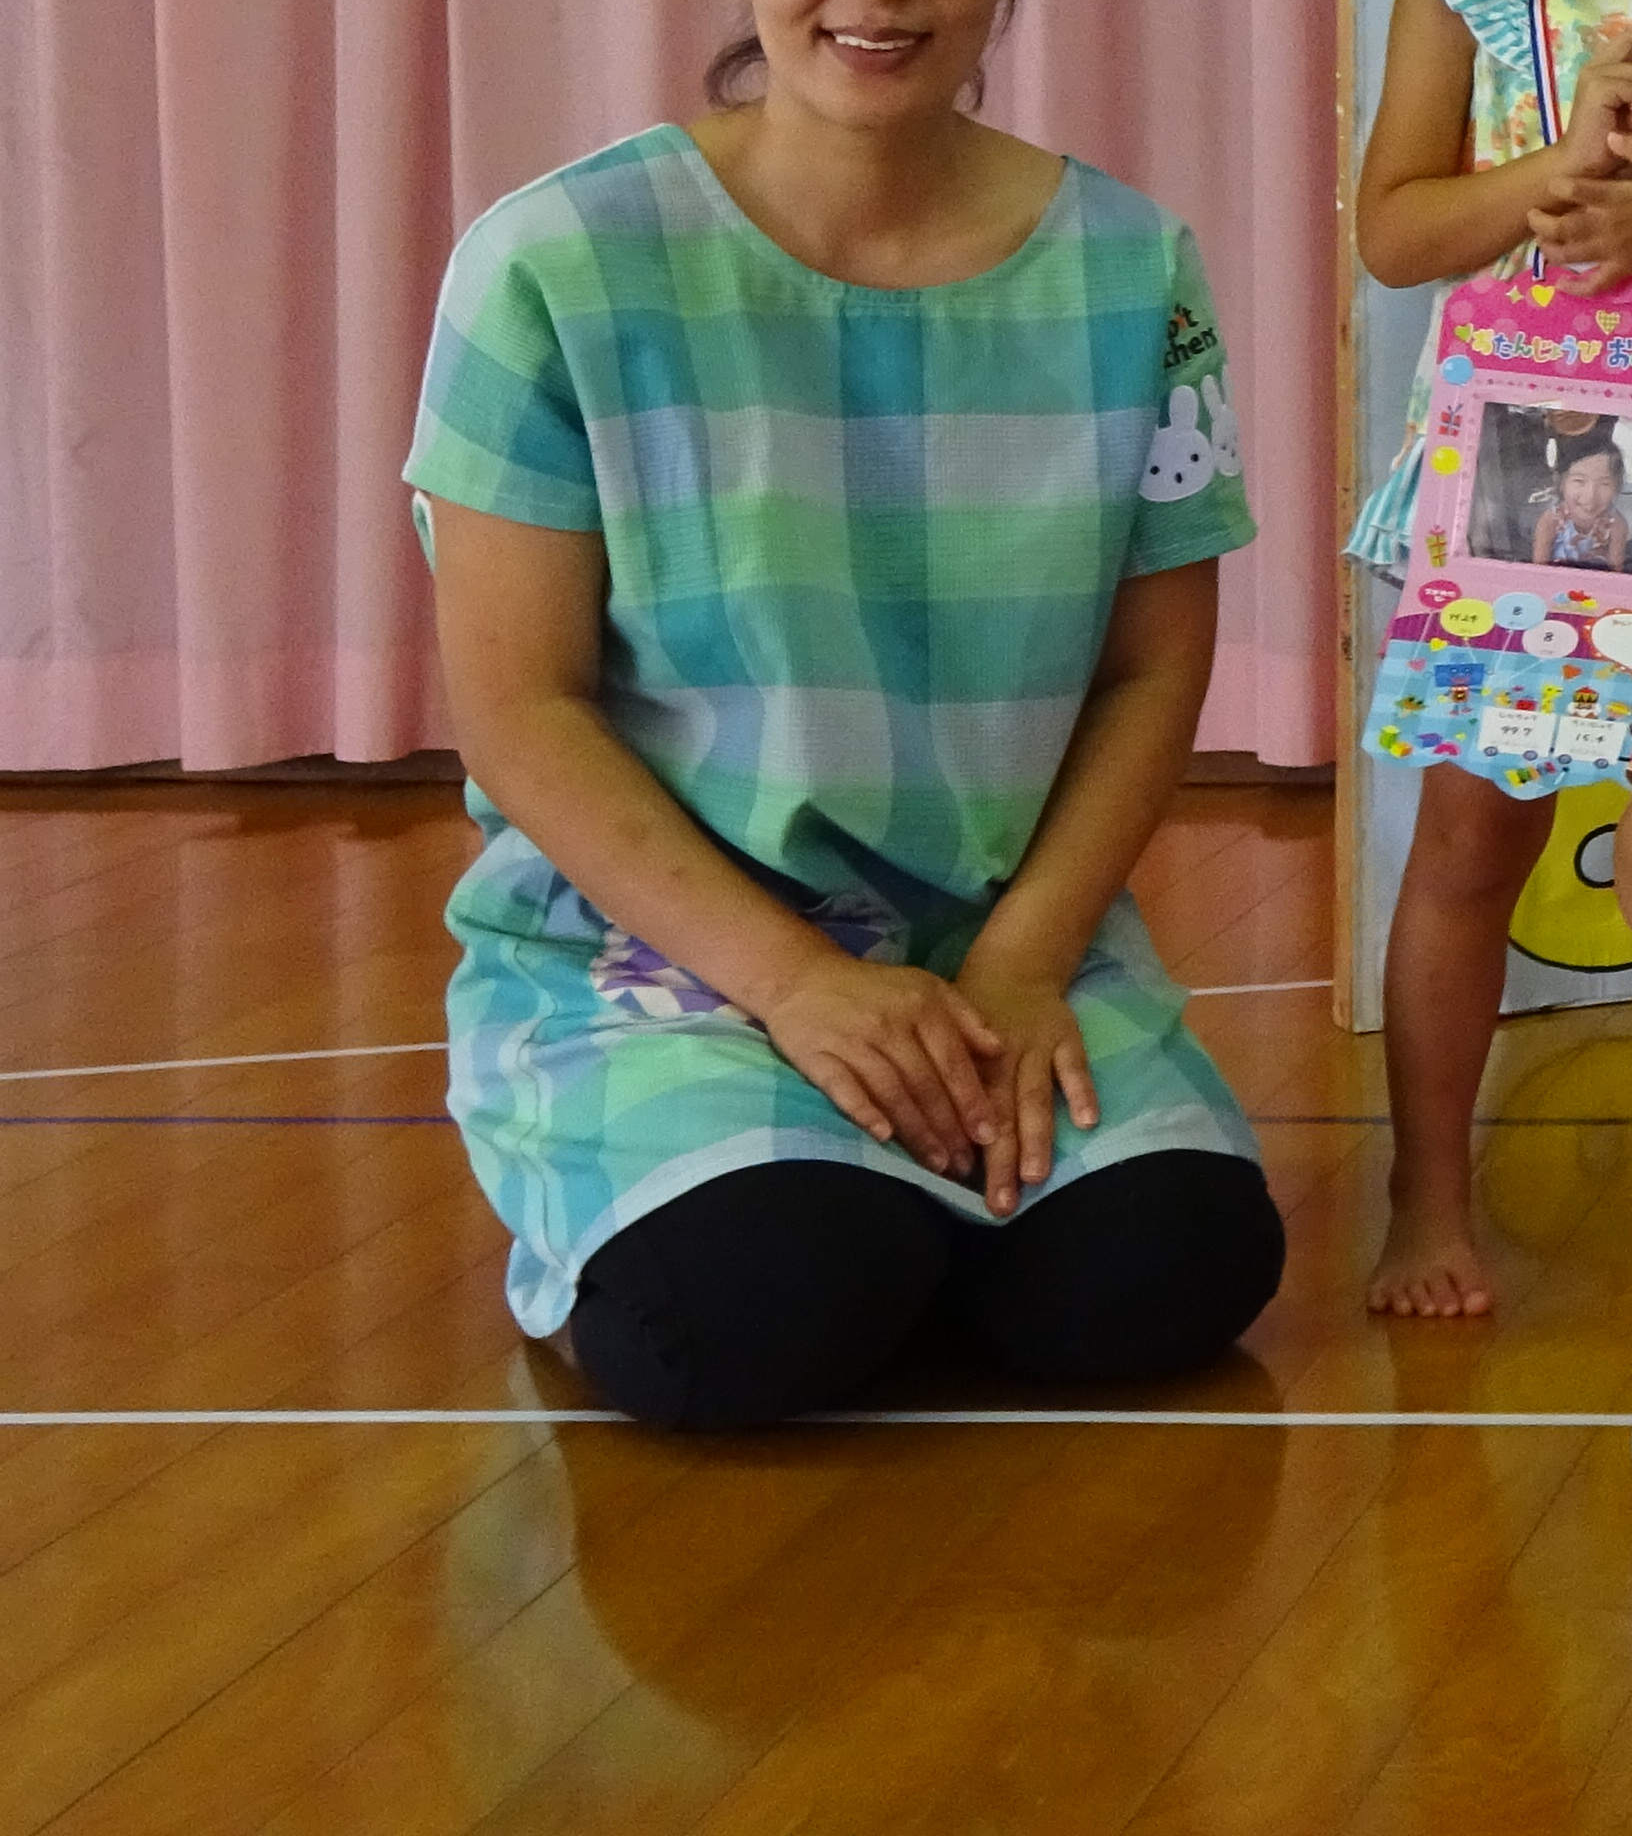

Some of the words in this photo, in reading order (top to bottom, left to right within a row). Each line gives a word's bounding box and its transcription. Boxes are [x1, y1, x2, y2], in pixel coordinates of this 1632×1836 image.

[1472, 328, 1602, 365] おたんじょうび
